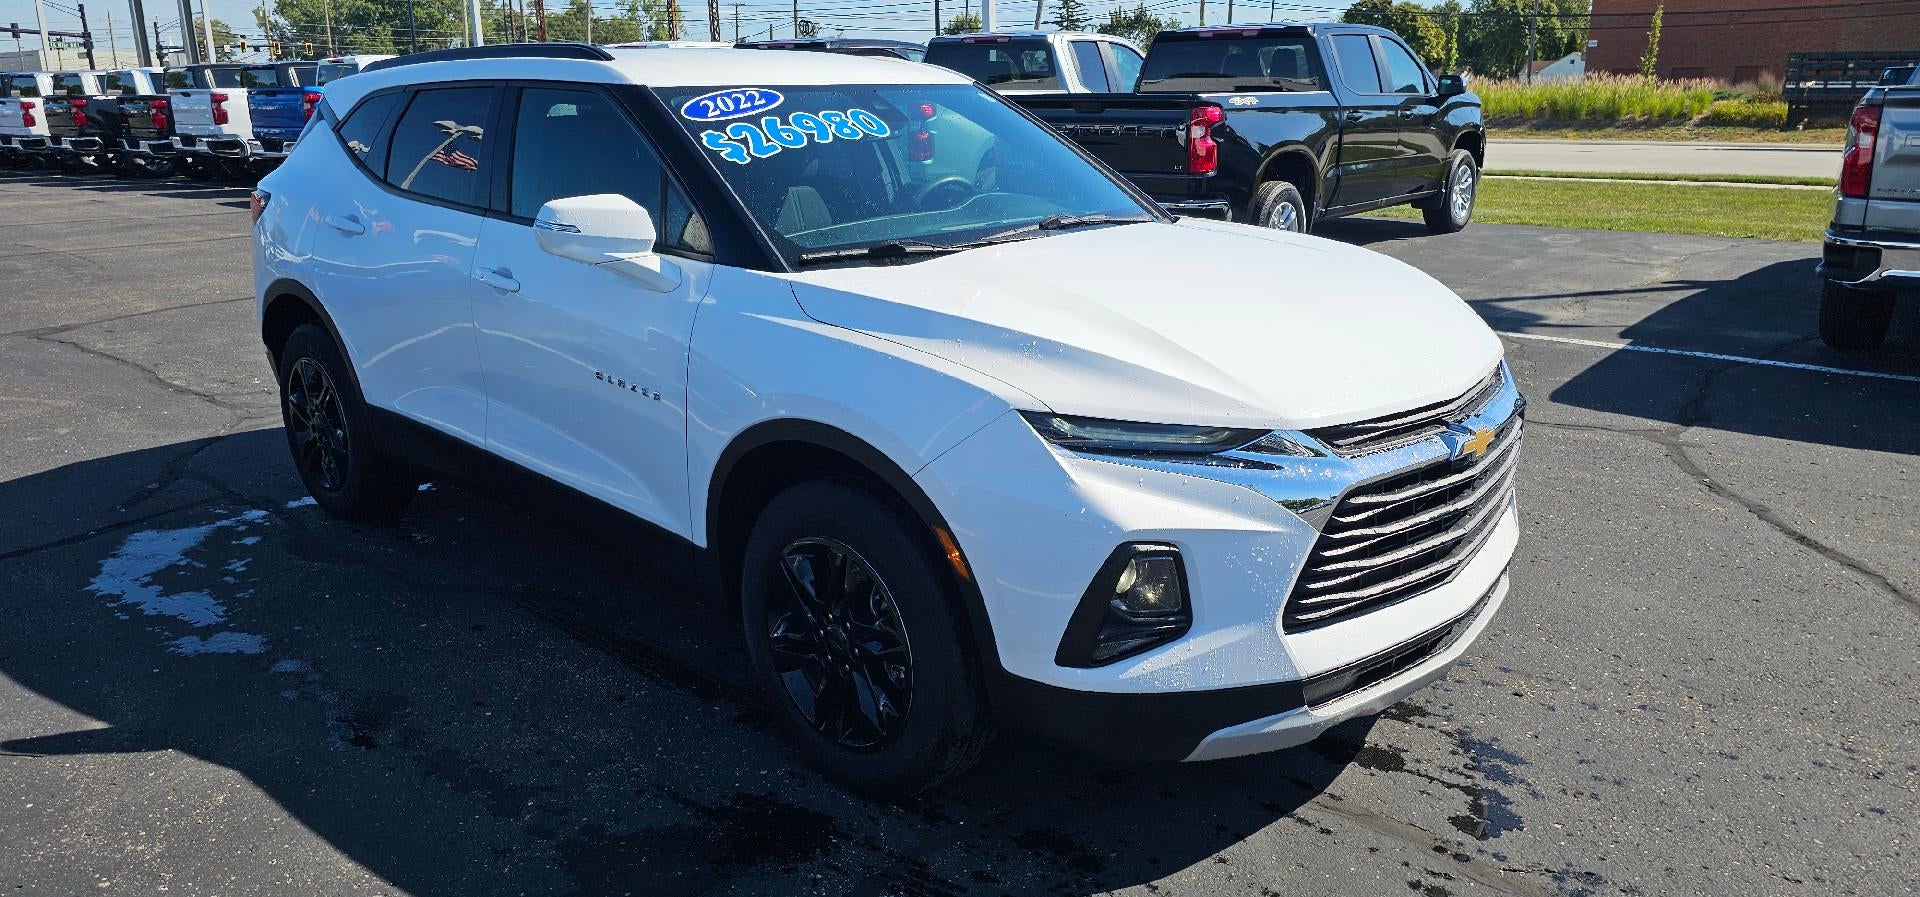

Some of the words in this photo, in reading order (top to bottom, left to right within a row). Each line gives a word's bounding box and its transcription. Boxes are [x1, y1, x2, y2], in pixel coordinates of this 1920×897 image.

[700, 90, 767, 117] 2022
[700, 109, 890, 164] $26980
[595, 370, 661, 401] BLAZER
